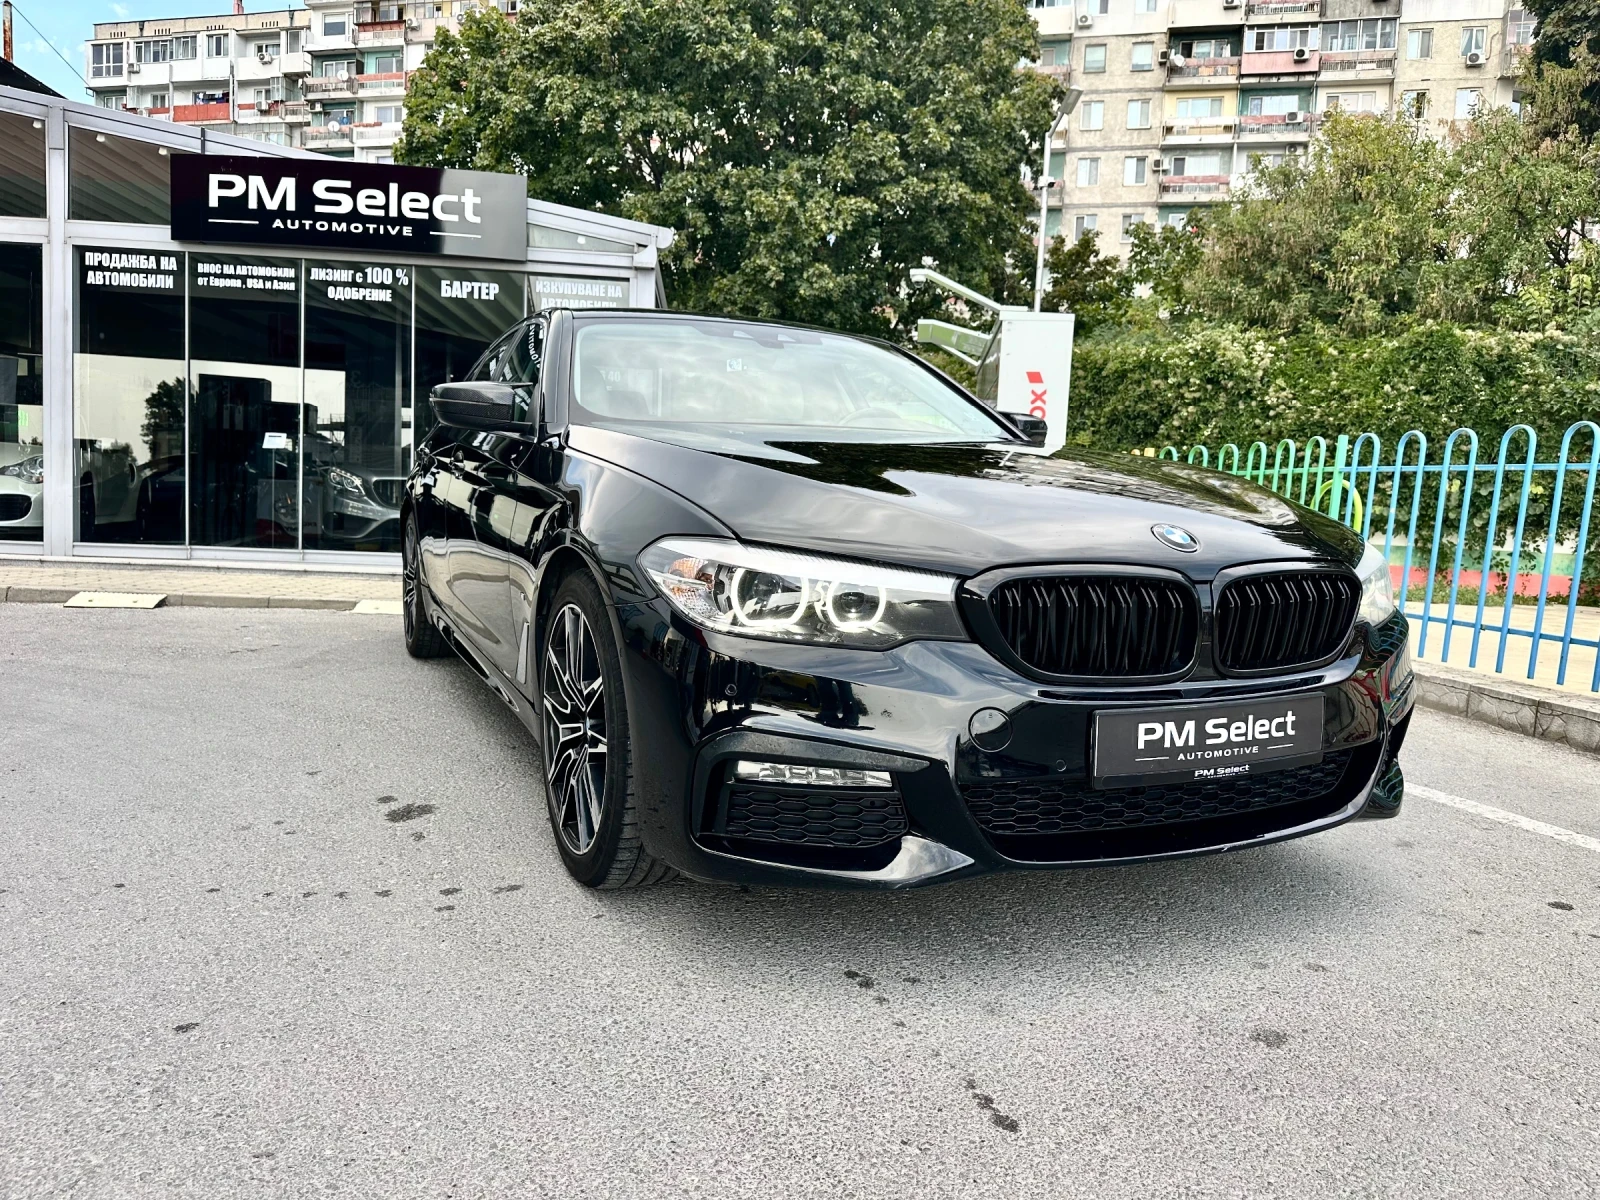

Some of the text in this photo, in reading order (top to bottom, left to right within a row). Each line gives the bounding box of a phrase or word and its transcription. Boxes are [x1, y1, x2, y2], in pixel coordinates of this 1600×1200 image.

[208, 173, 482, 224] PM Select
[272, 218, 413, 237] AUTOMOTIVE
[84, 251, 178, 271] ПРОДАЖБА НА
[197, 262, 295, 278] ВНОС НА АВТОМОБИЛИ
[86, 270, 174, 289] АВТОМОБИЛИ
[197, 276, 208, 286] от
[209, 276, 242, 288] Европа
[246, 278, 264, 289] USA
[272, 279, 296, 291] Азия
[310, 267, 354, 282] ЛИЗИНГ
[365, 266, 393, 285] 100
[395, 268, 409, 286] %
[327, 285, 393, 302] ОДОБРЕНИЕ
[440, 279, 500, 301] БАРТЕР
[535, 280, 623, 298] ИЗКУПУВАНЕ НА
[1137, 710, 1296, 750] PM Select
[1177, 745, 1259, 761] AUTOMOTIVE
[1194, 768, 1215, 777] PM
[1216, 764, 1250, 775] Select
